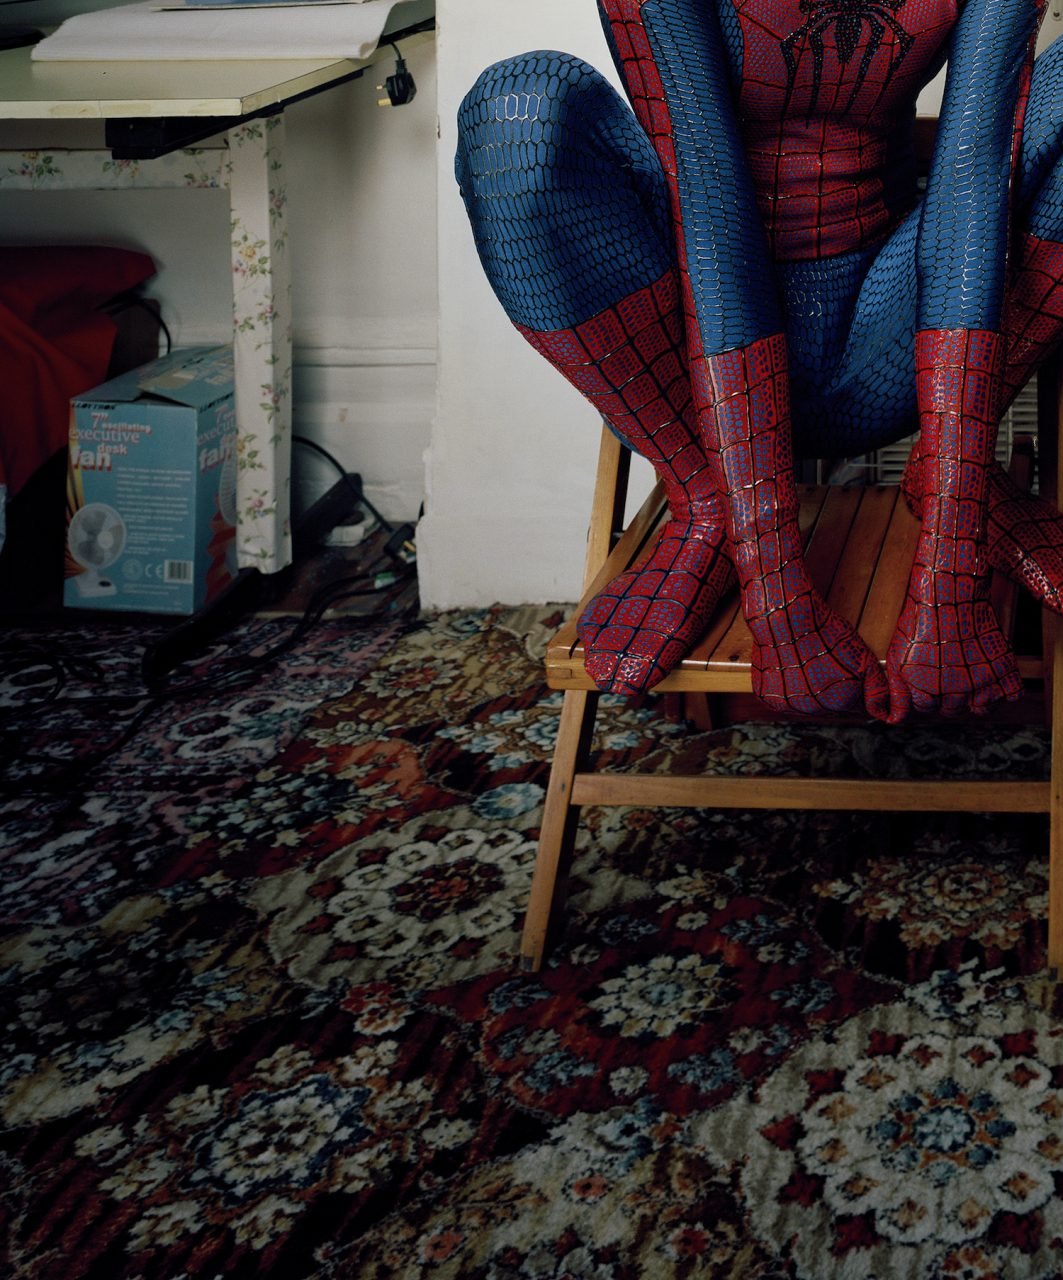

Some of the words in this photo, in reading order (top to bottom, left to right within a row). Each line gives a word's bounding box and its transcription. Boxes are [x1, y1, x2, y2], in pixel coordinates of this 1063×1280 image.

[69, 428, 140, 443] executive
[97, 442, 129, 455] desk
[71, 444, 112, 471] fan
